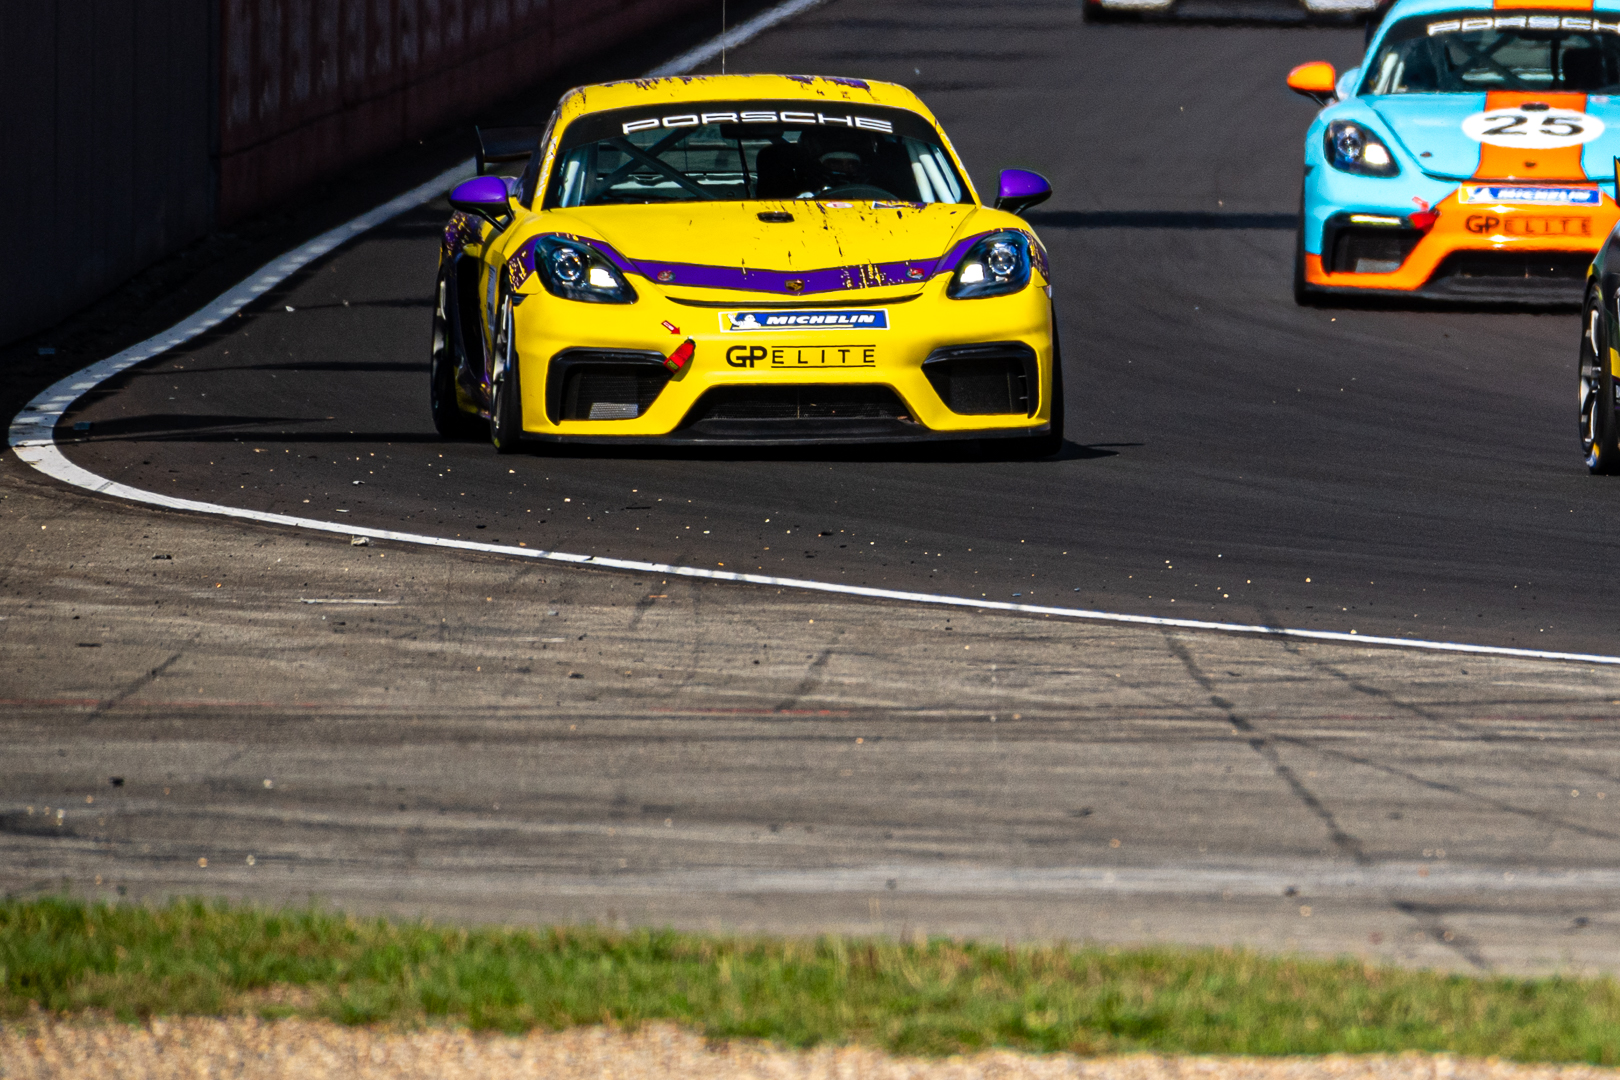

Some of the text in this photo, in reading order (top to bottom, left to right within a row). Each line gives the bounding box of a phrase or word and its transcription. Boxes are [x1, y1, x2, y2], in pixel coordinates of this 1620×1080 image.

[622, 111, 893, 135] PORSCHE
[1481, 115, 1585, 137] 25
[766, 314, 876, 325] MICHELIN
